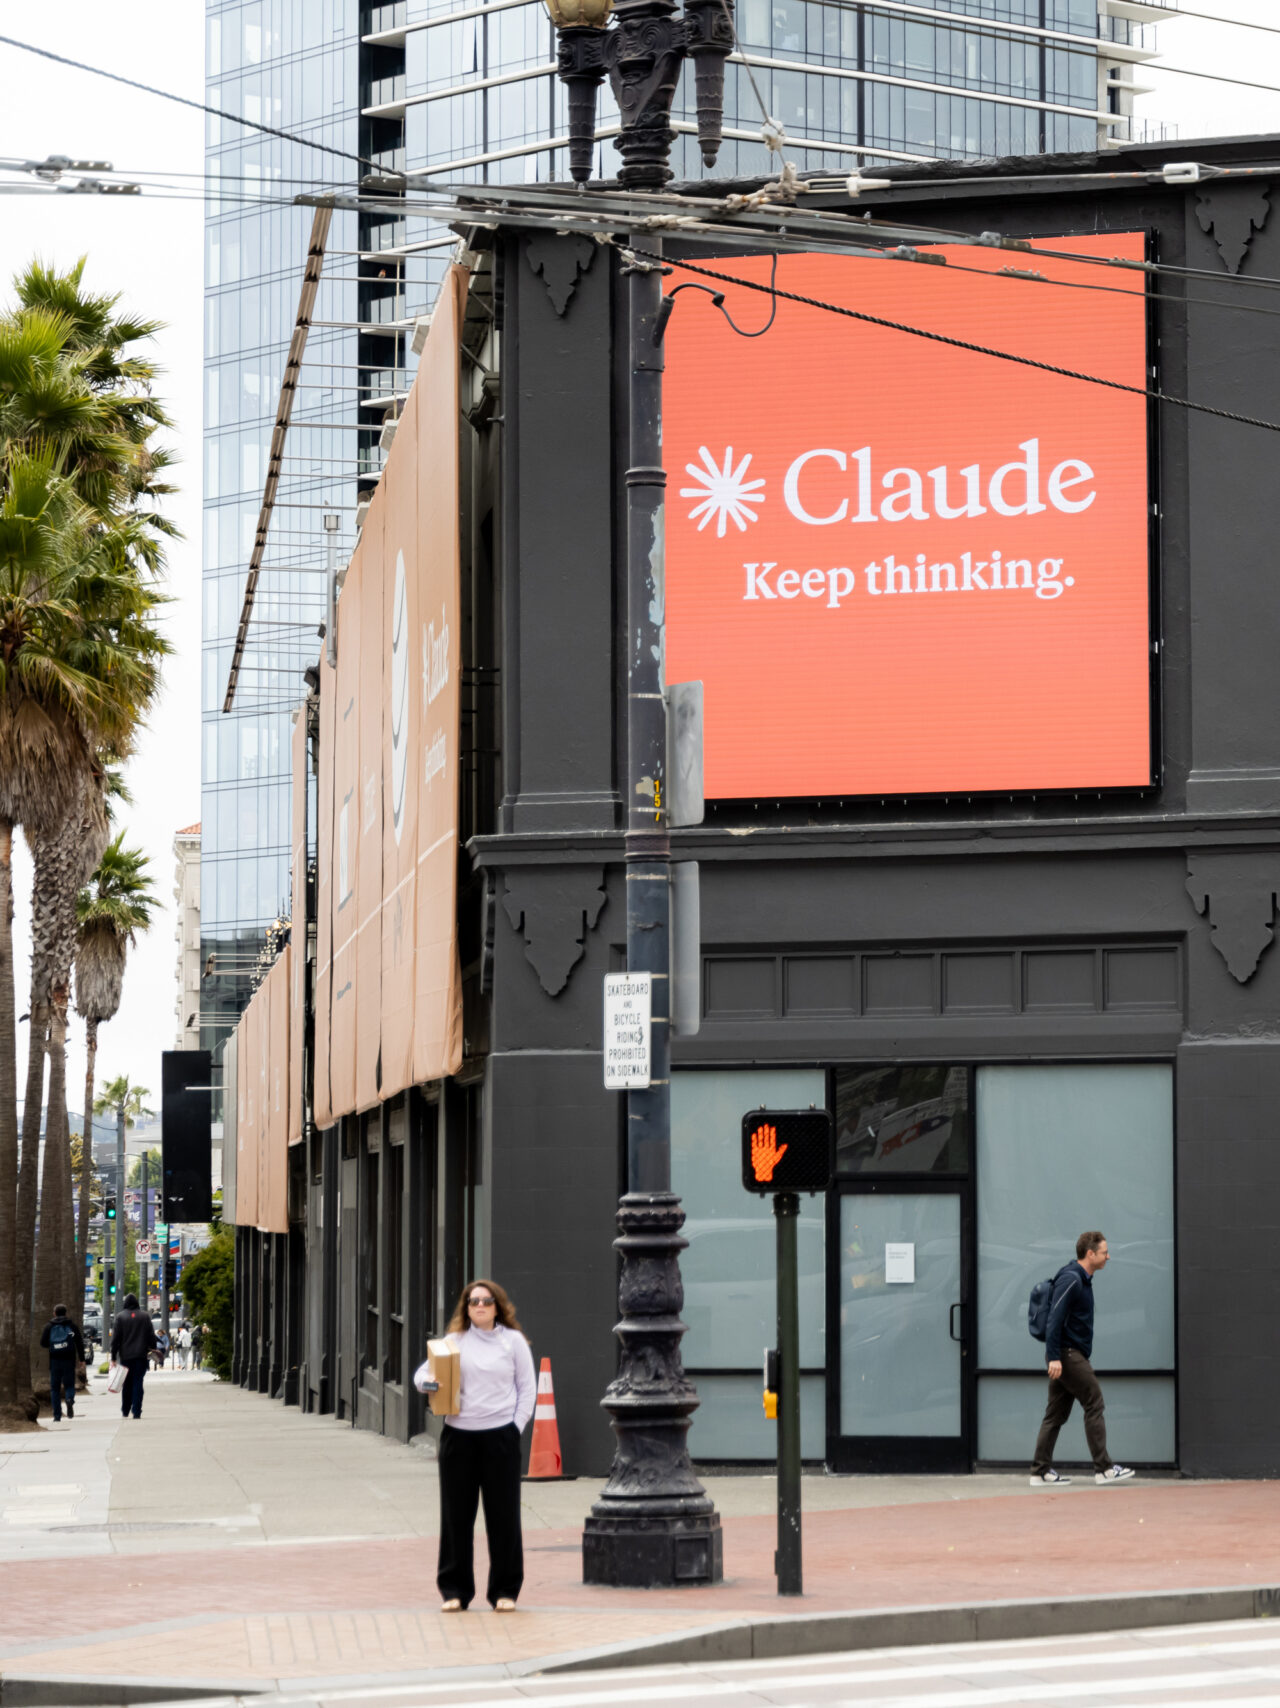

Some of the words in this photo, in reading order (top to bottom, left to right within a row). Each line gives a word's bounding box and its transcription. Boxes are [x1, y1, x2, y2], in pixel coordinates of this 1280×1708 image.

[784, 438, 1097, 526] Claude
[743, 561, 856, 608] Keep
[864, 551, 1075, 600] thinking.
[607, 983, 649, 997] SKATEBOARD
[614, 1013, 641, 1026] BICYCLE
[616, 1031, 640, 1044] RIDING
[608, 1047, 646, 1061] PROHIBITED
[606, 1065, 616, 1077] ON
[618, 1064, 649, 1077] SIDEWALK
